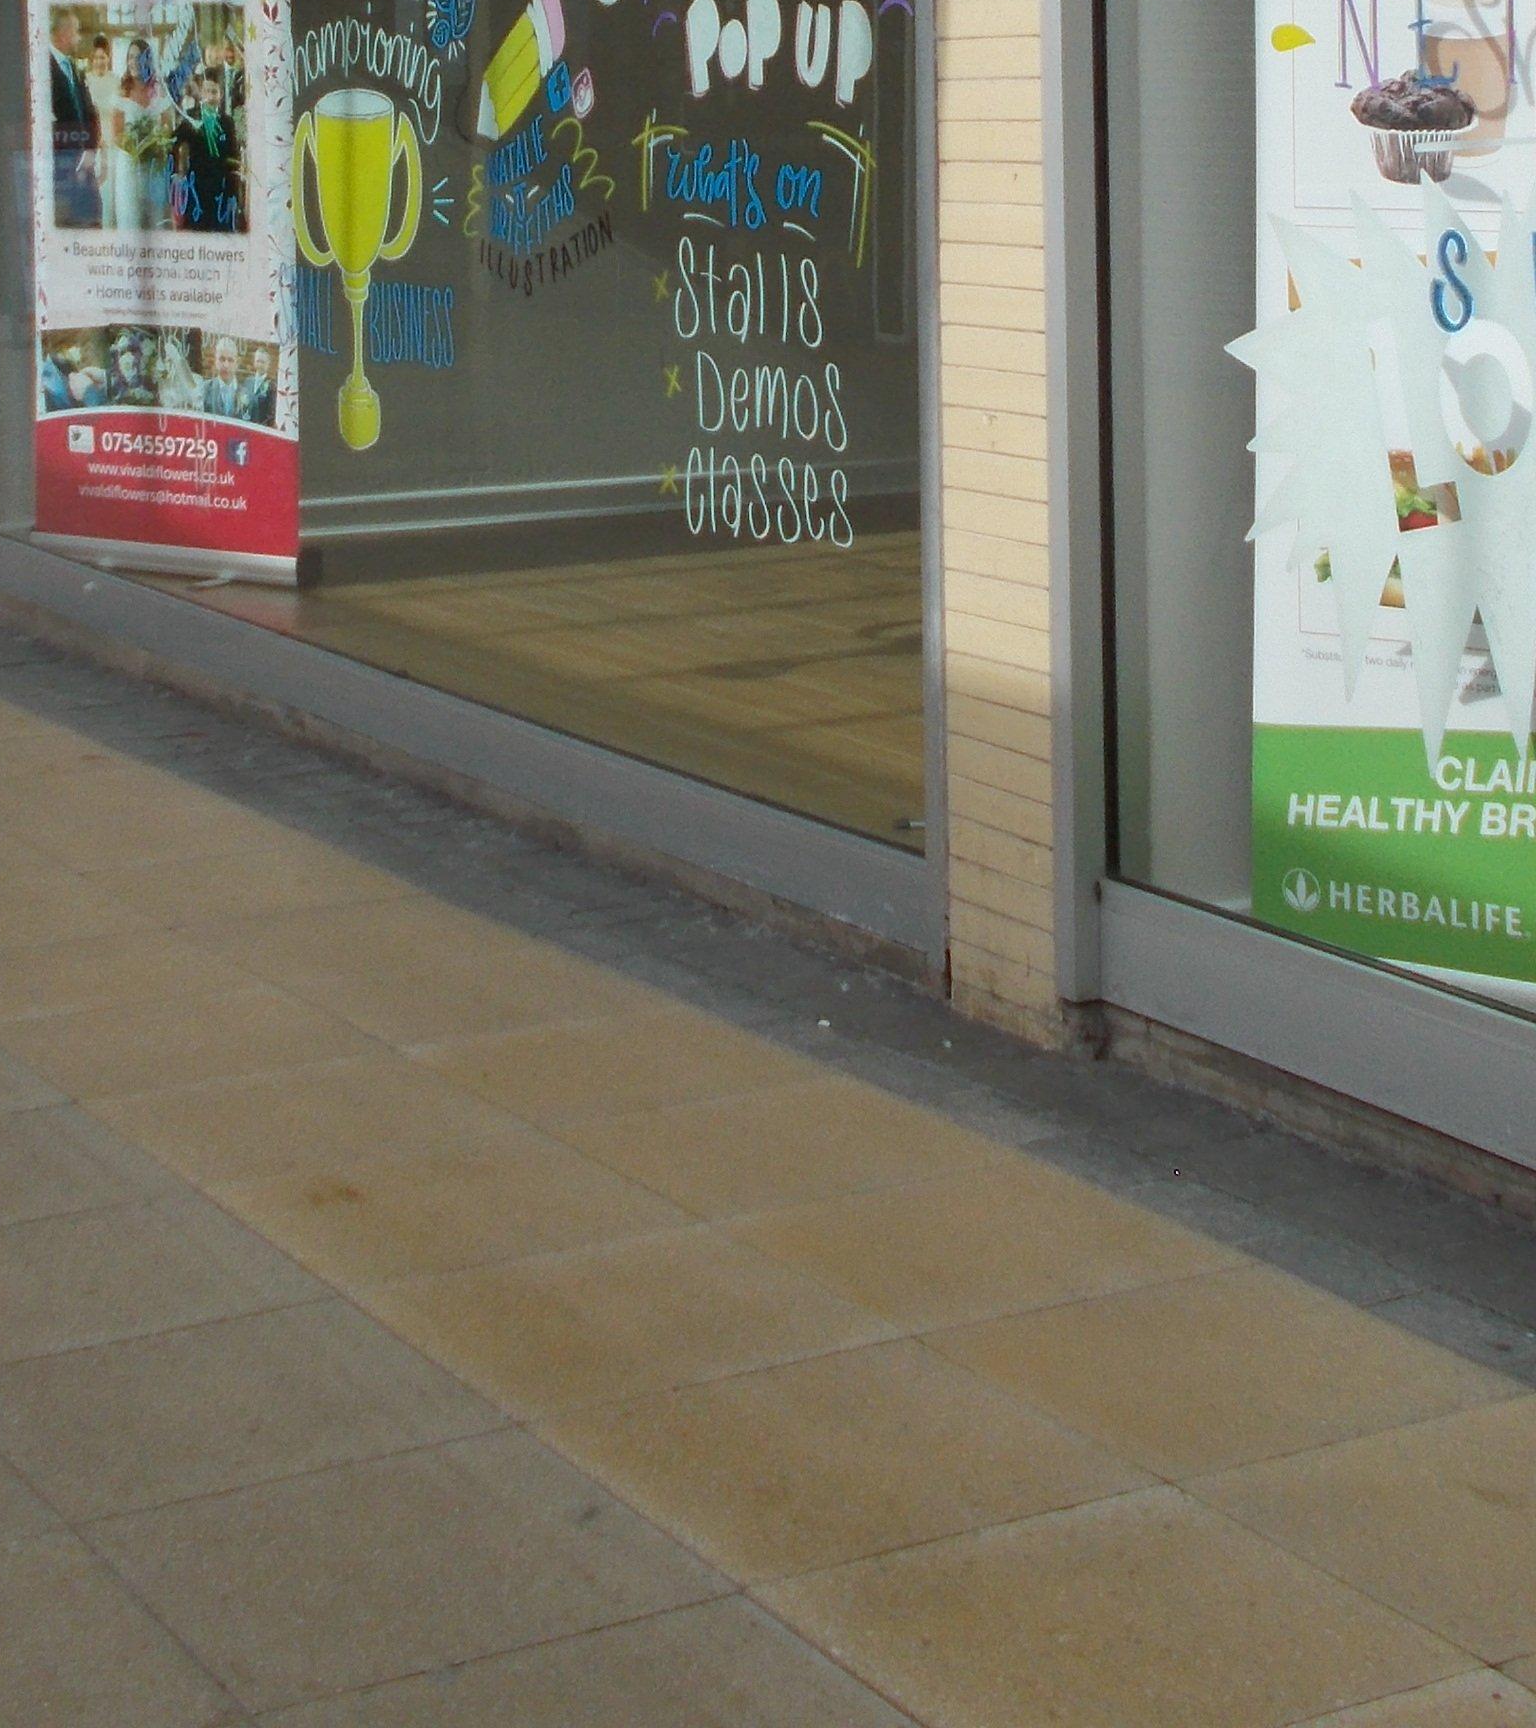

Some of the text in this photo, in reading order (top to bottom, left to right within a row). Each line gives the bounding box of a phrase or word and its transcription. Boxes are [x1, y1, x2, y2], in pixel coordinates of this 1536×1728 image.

[290, 1, 442, 145] hampioning
[794, 0, 873, 108] UP
[775, 161, 822, 219] on
[72, 242, 137, 261] Beautifully
[198, 245, 246, 264] flowers
[95, 285, 133, 300] Home
[169, 287, 224, 305] available
[479, 208, 614, 297] ILLUSTRATION
[673, 236, 824, 349] Stalls
[368, 280, 455, 369] BUSINESS
[101, 431, 219, 460] 07545597259
[696, 350, 848, 452] Demos
[684, 446, 854, 549] Classes
[1285, 792, 1467, 836] HEALTHY
